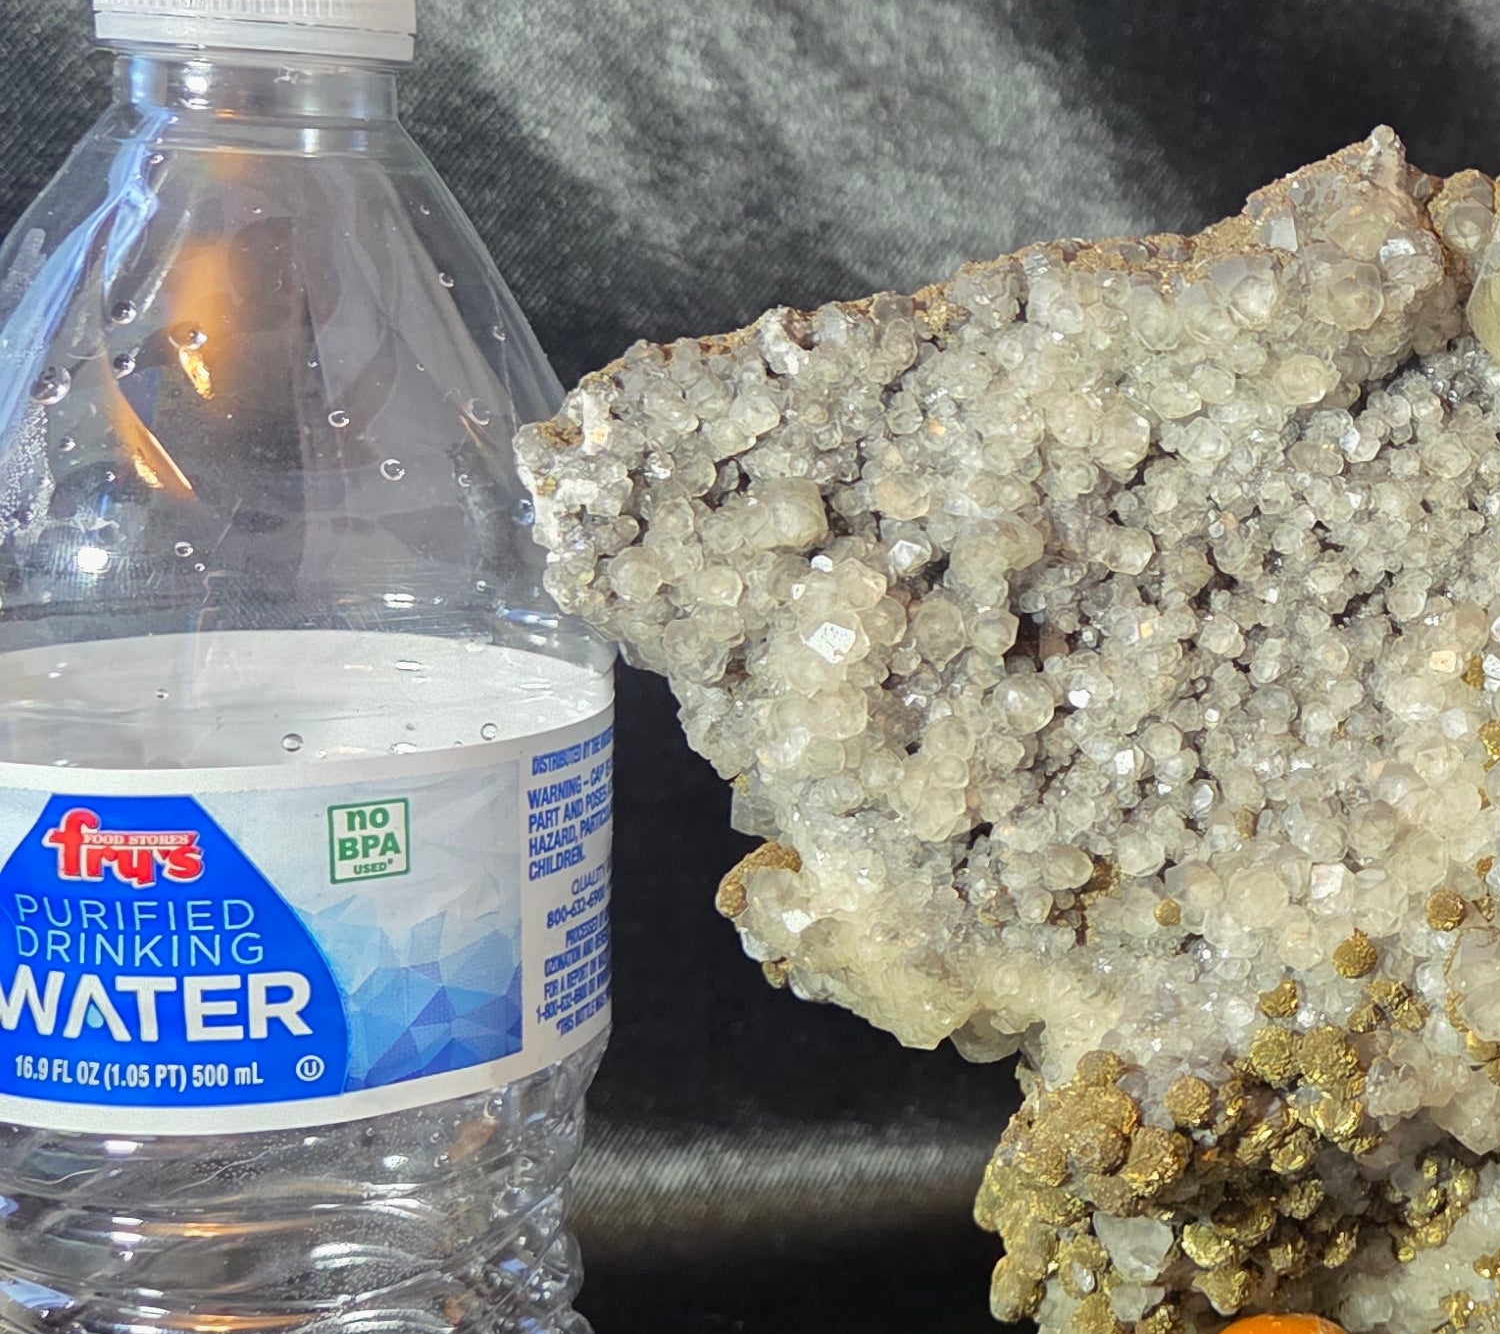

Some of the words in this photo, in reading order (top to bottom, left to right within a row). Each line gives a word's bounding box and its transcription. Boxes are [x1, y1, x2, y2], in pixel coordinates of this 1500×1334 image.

[527, 775, 582, 810] WARNING
[346, 807, 390, 831] no
[528, 806, 561, 835] PART
[563, 798, 584, 824] AND
[83, 833, 125, 846] FOOD
[127, 833, 189, 846] STORES
[338, 832, 402, 861] BPA
[528, 824, 578, 858] HAZARD,
[15, 893, 255, 931] PURIFIED
[15, 925, 264, 967] DRINKING
[0, 963, 314, 1042] WATER
[15, 1054, 48, 1081] 16.9
[52, 1059, 73, 1083] FL
[76, 1061, 100, 1086] OZ
[104, 1062, 150, 1091] (1.05
[155, 1064, 187, 1092] PT)
[192, 1063, 229, 1087] 500
[234, 1061, 264, 1085] mL
